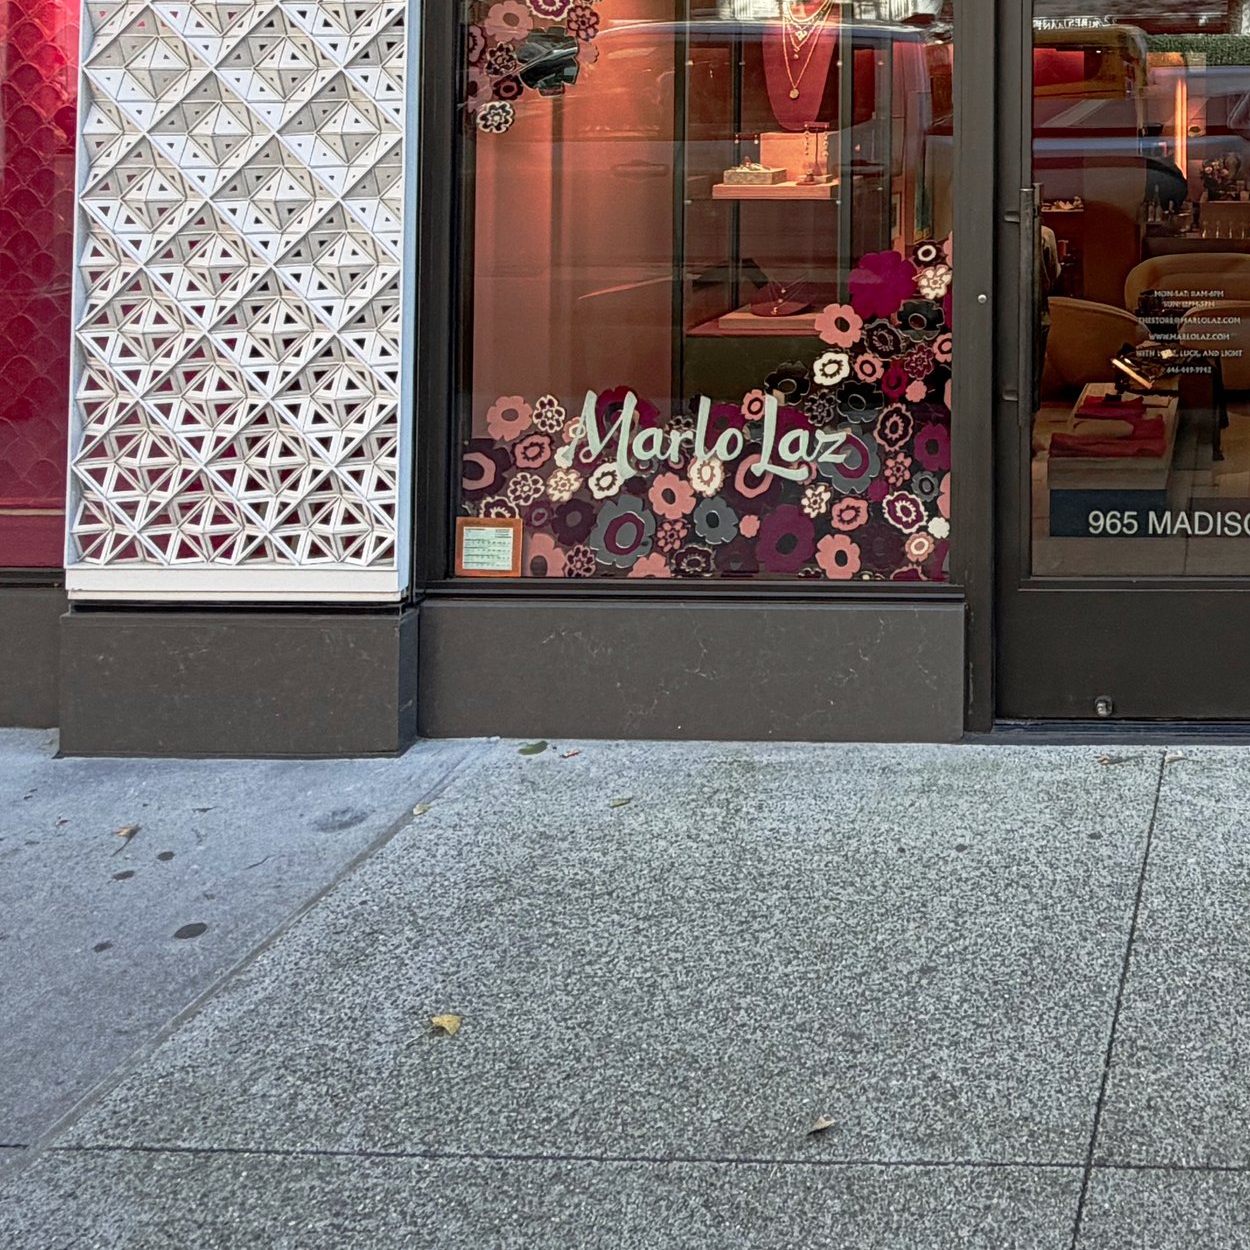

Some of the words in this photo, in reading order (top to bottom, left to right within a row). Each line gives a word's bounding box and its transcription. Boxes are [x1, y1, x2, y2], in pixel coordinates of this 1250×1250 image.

[1202, 349, 1219, 357] AND
[556, 390, 744, 479] Marlo
[752, 394, 852, 481] Laz
[1088, 510, 1138, 535] 965
